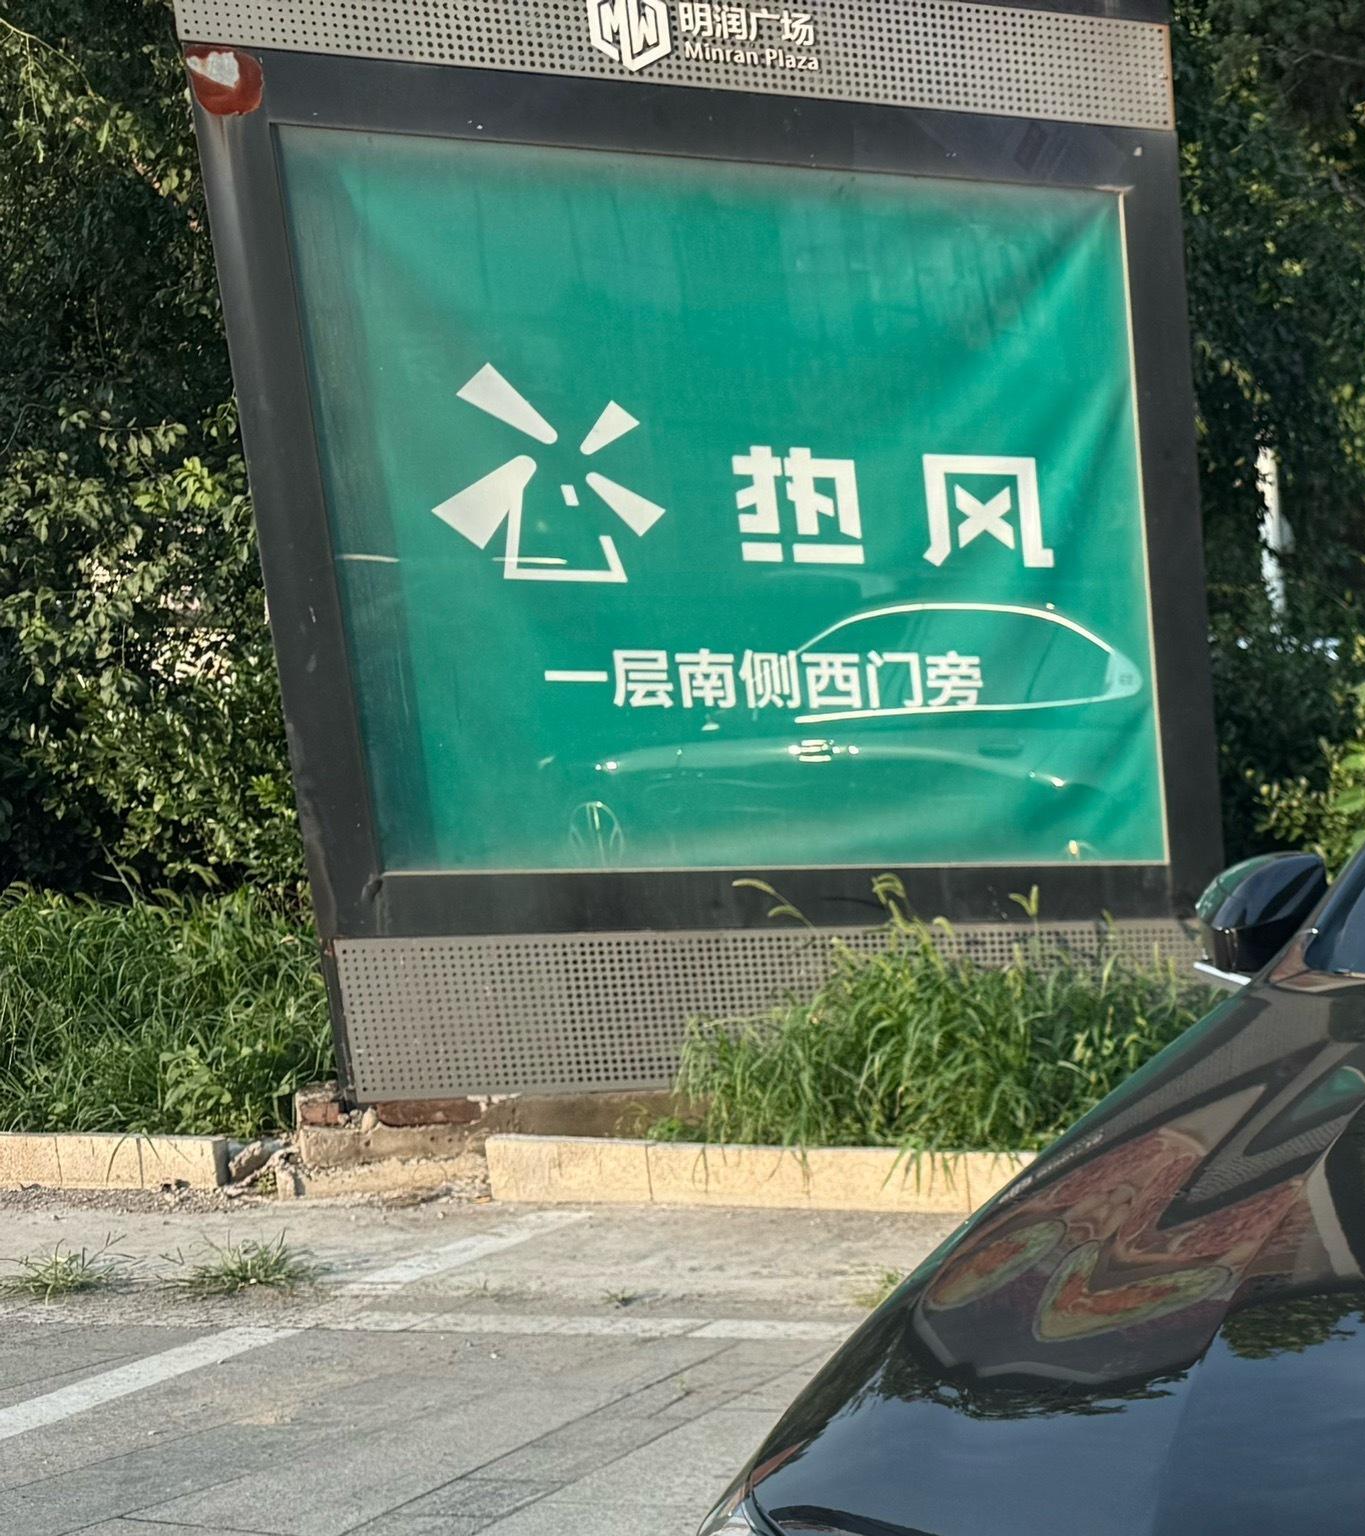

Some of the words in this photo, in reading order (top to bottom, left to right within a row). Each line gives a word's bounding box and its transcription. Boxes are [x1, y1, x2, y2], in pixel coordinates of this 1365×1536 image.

[678, 2, 815, 46] 明润广场
[684, 40, 759, 65] Minran
[765, 48, 820, 71] Plaza
[732, 445, 1056, 568] 热风
[544, 648, 985, 710] 一层南侧西门旁
